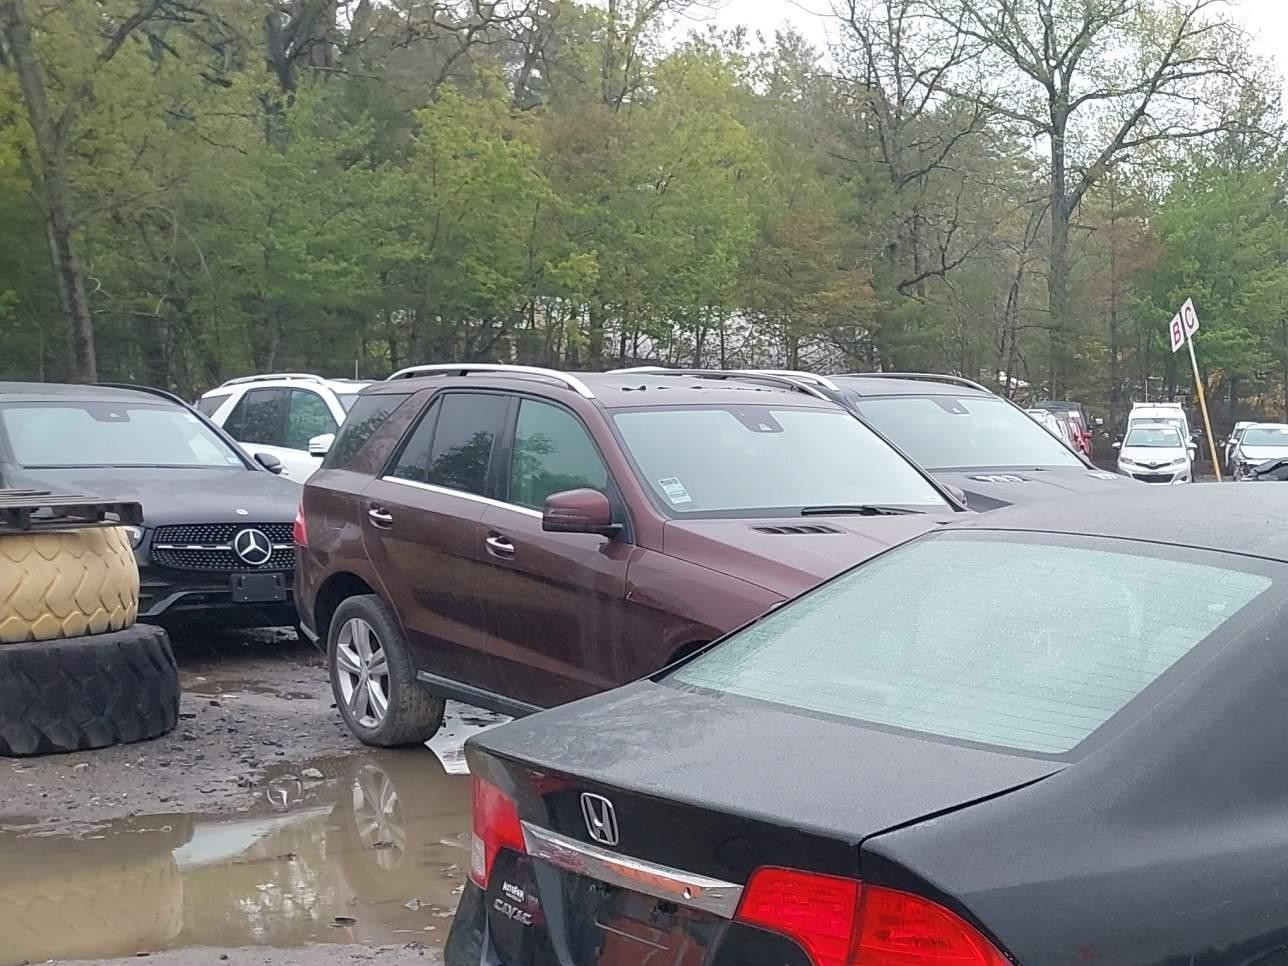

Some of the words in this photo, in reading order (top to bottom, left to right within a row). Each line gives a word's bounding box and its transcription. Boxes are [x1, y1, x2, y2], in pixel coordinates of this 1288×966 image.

[1185, 306, 1195, 330] C
[1172, 321, 1181, 347] B
[493, 898, 533, 926] CIVIC
